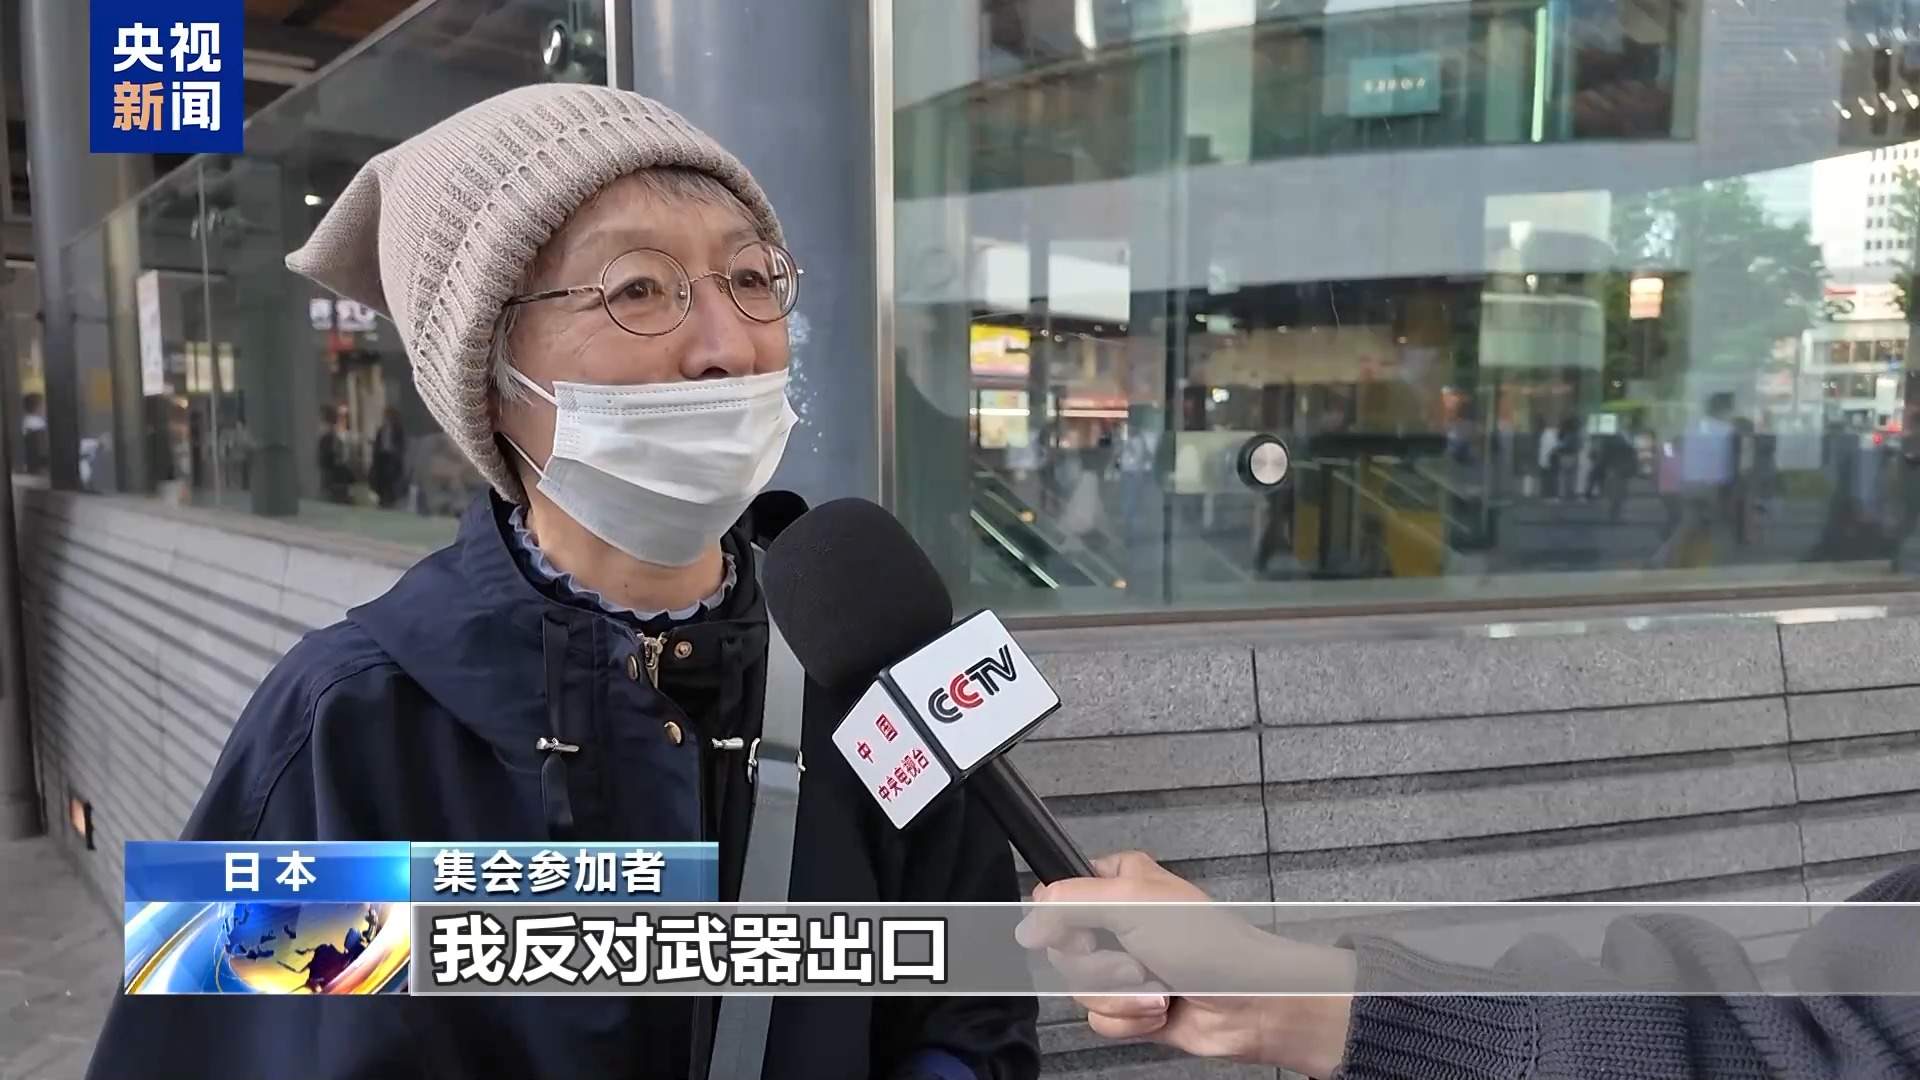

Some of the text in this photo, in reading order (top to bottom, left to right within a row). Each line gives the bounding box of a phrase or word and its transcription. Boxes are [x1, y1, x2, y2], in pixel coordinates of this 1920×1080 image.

[927, 644, 1018, 724] CCTV
[878, 749, 929, 802] 中央电视台
